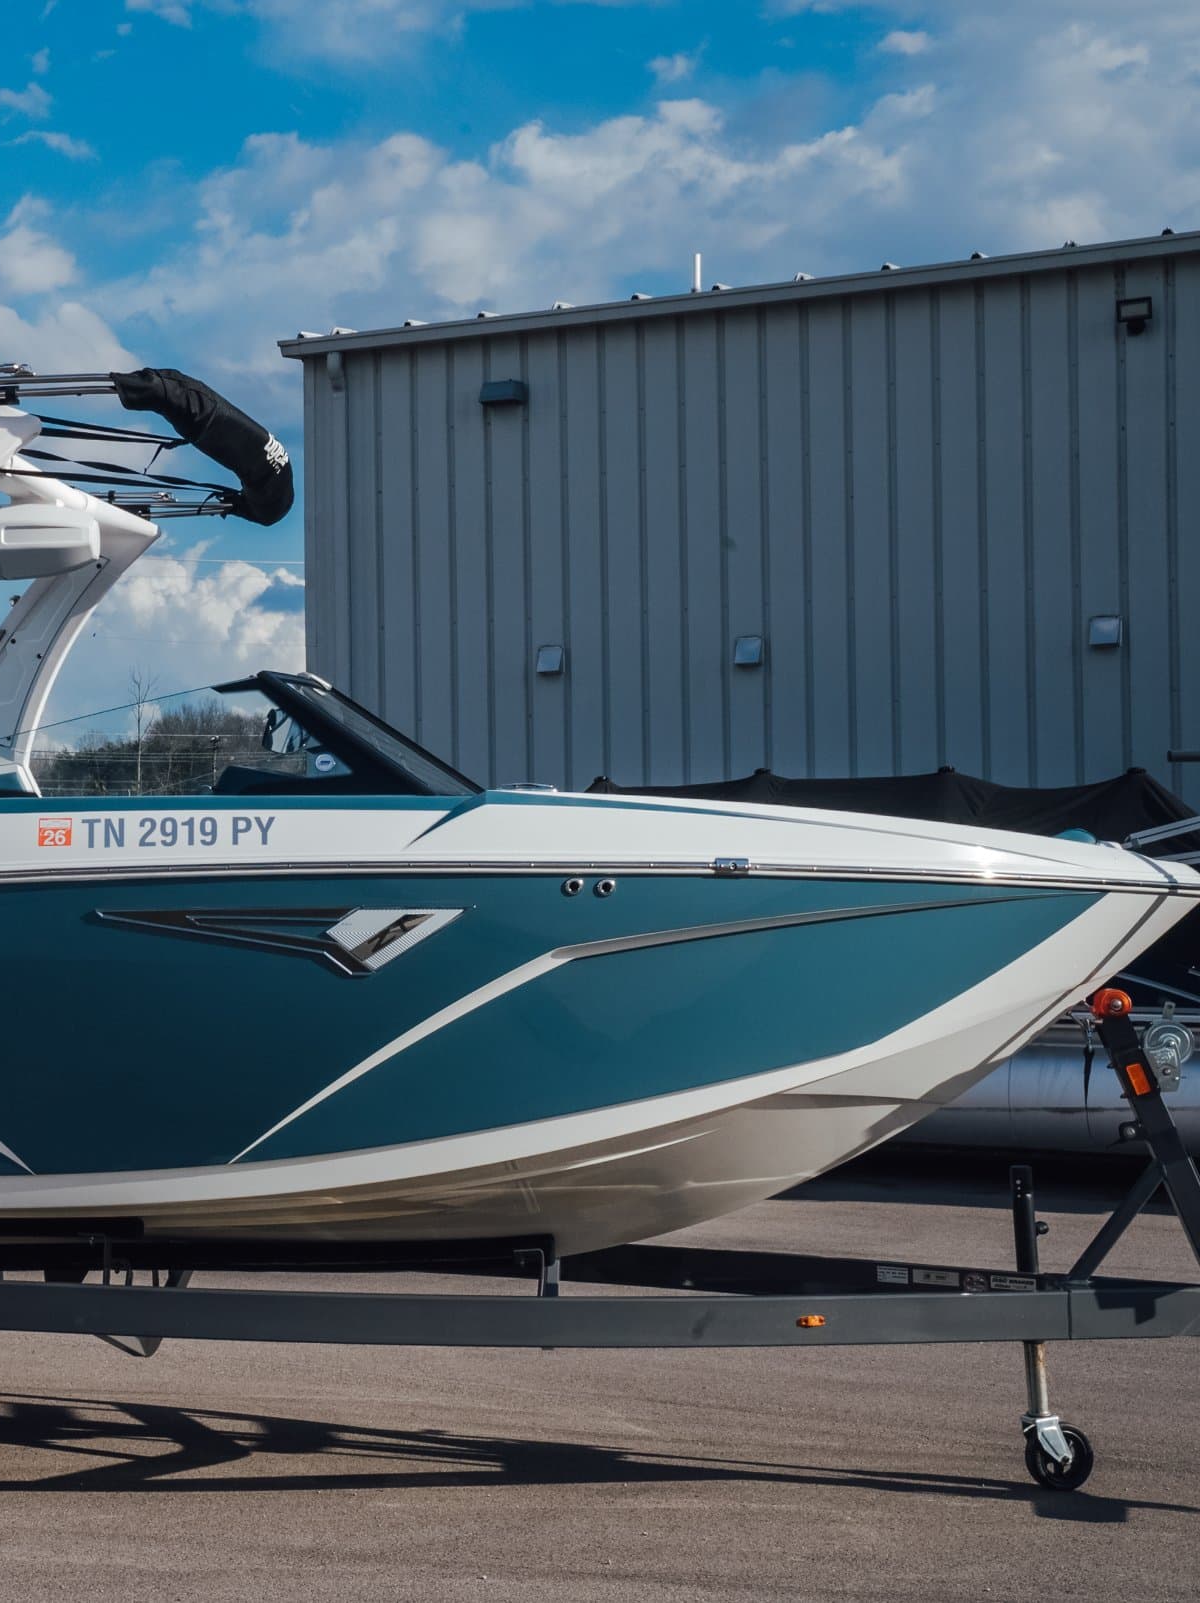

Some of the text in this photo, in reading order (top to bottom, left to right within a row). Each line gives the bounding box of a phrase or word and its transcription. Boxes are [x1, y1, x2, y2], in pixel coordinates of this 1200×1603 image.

[43, 829, 66, 846] 26
[81, 816, 276, 848] TN 2919 PY
